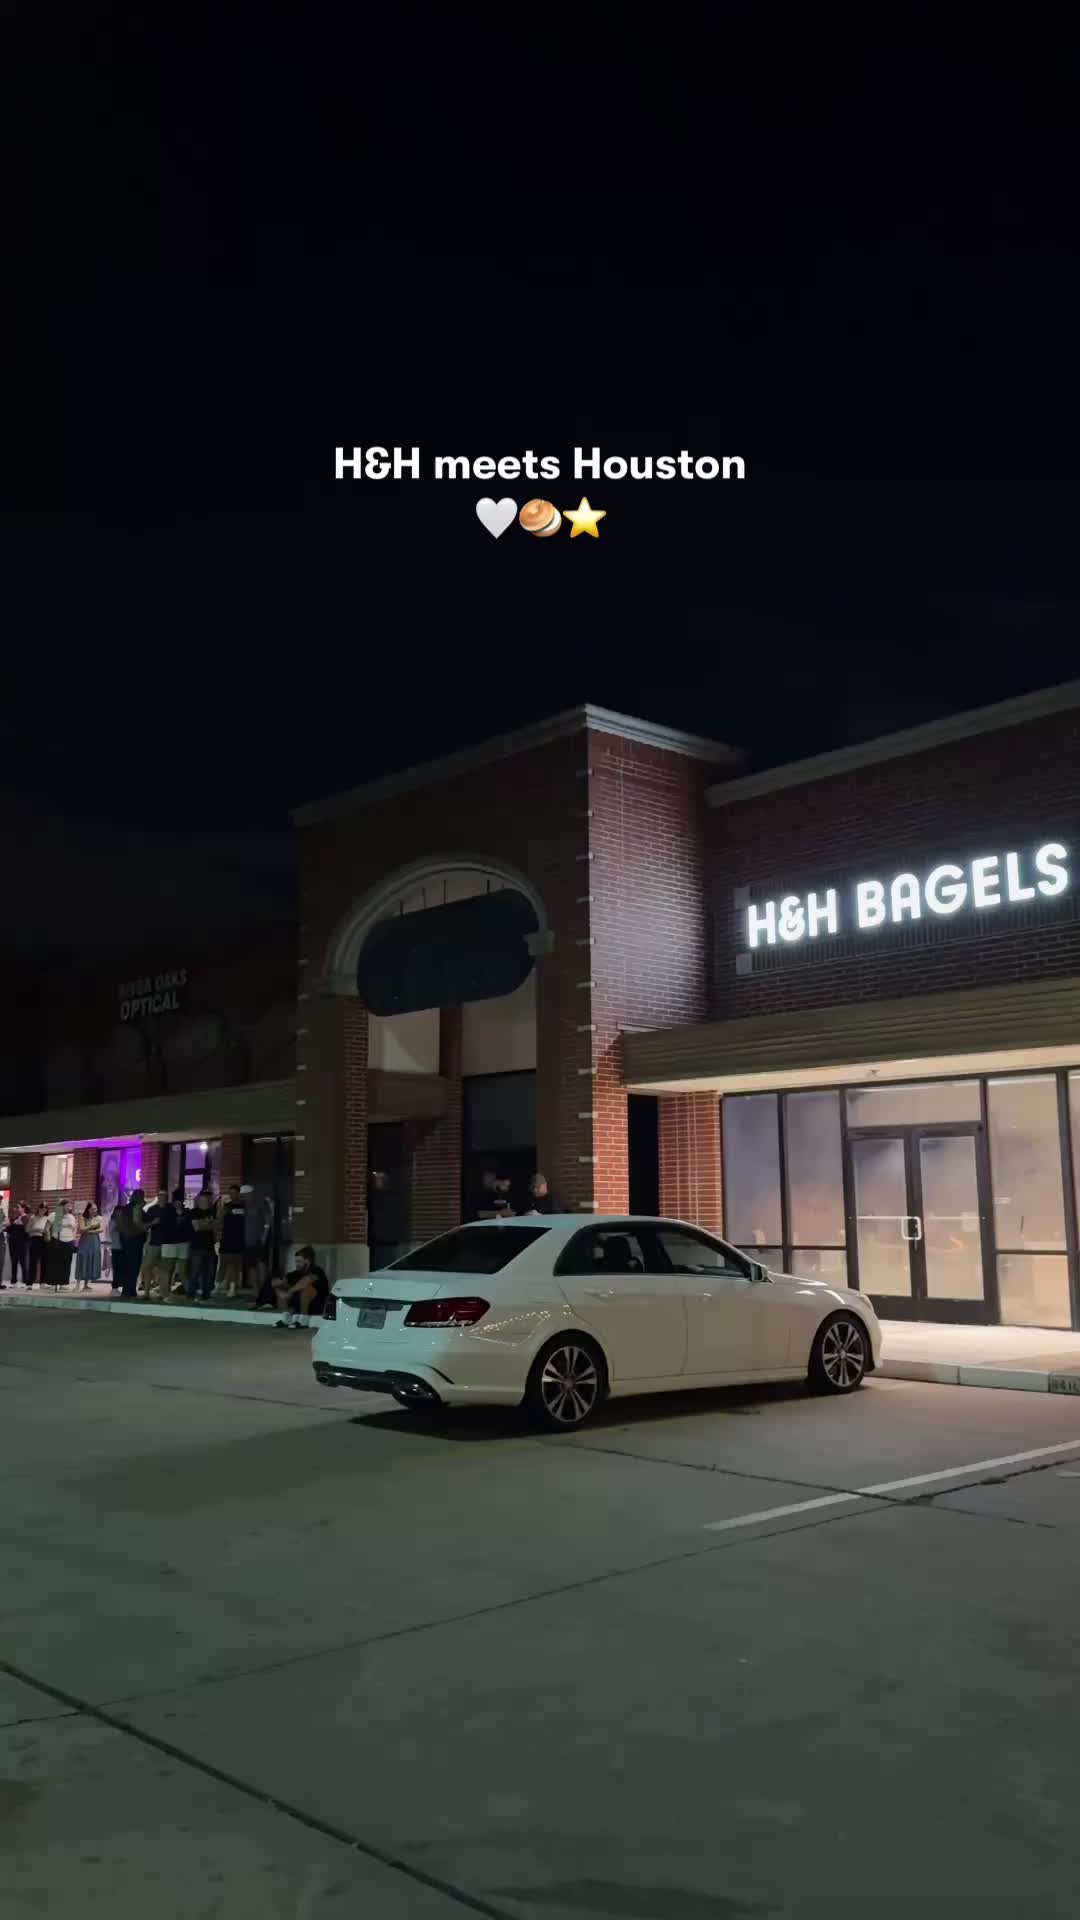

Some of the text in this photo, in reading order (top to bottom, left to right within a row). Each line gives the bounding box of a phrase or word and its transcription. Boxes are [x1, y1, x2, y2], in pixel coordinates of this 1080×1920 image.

[747, 843, 1069, 948] H&H BAGELS
[119, 991, 180, 1020] OPTICAL
